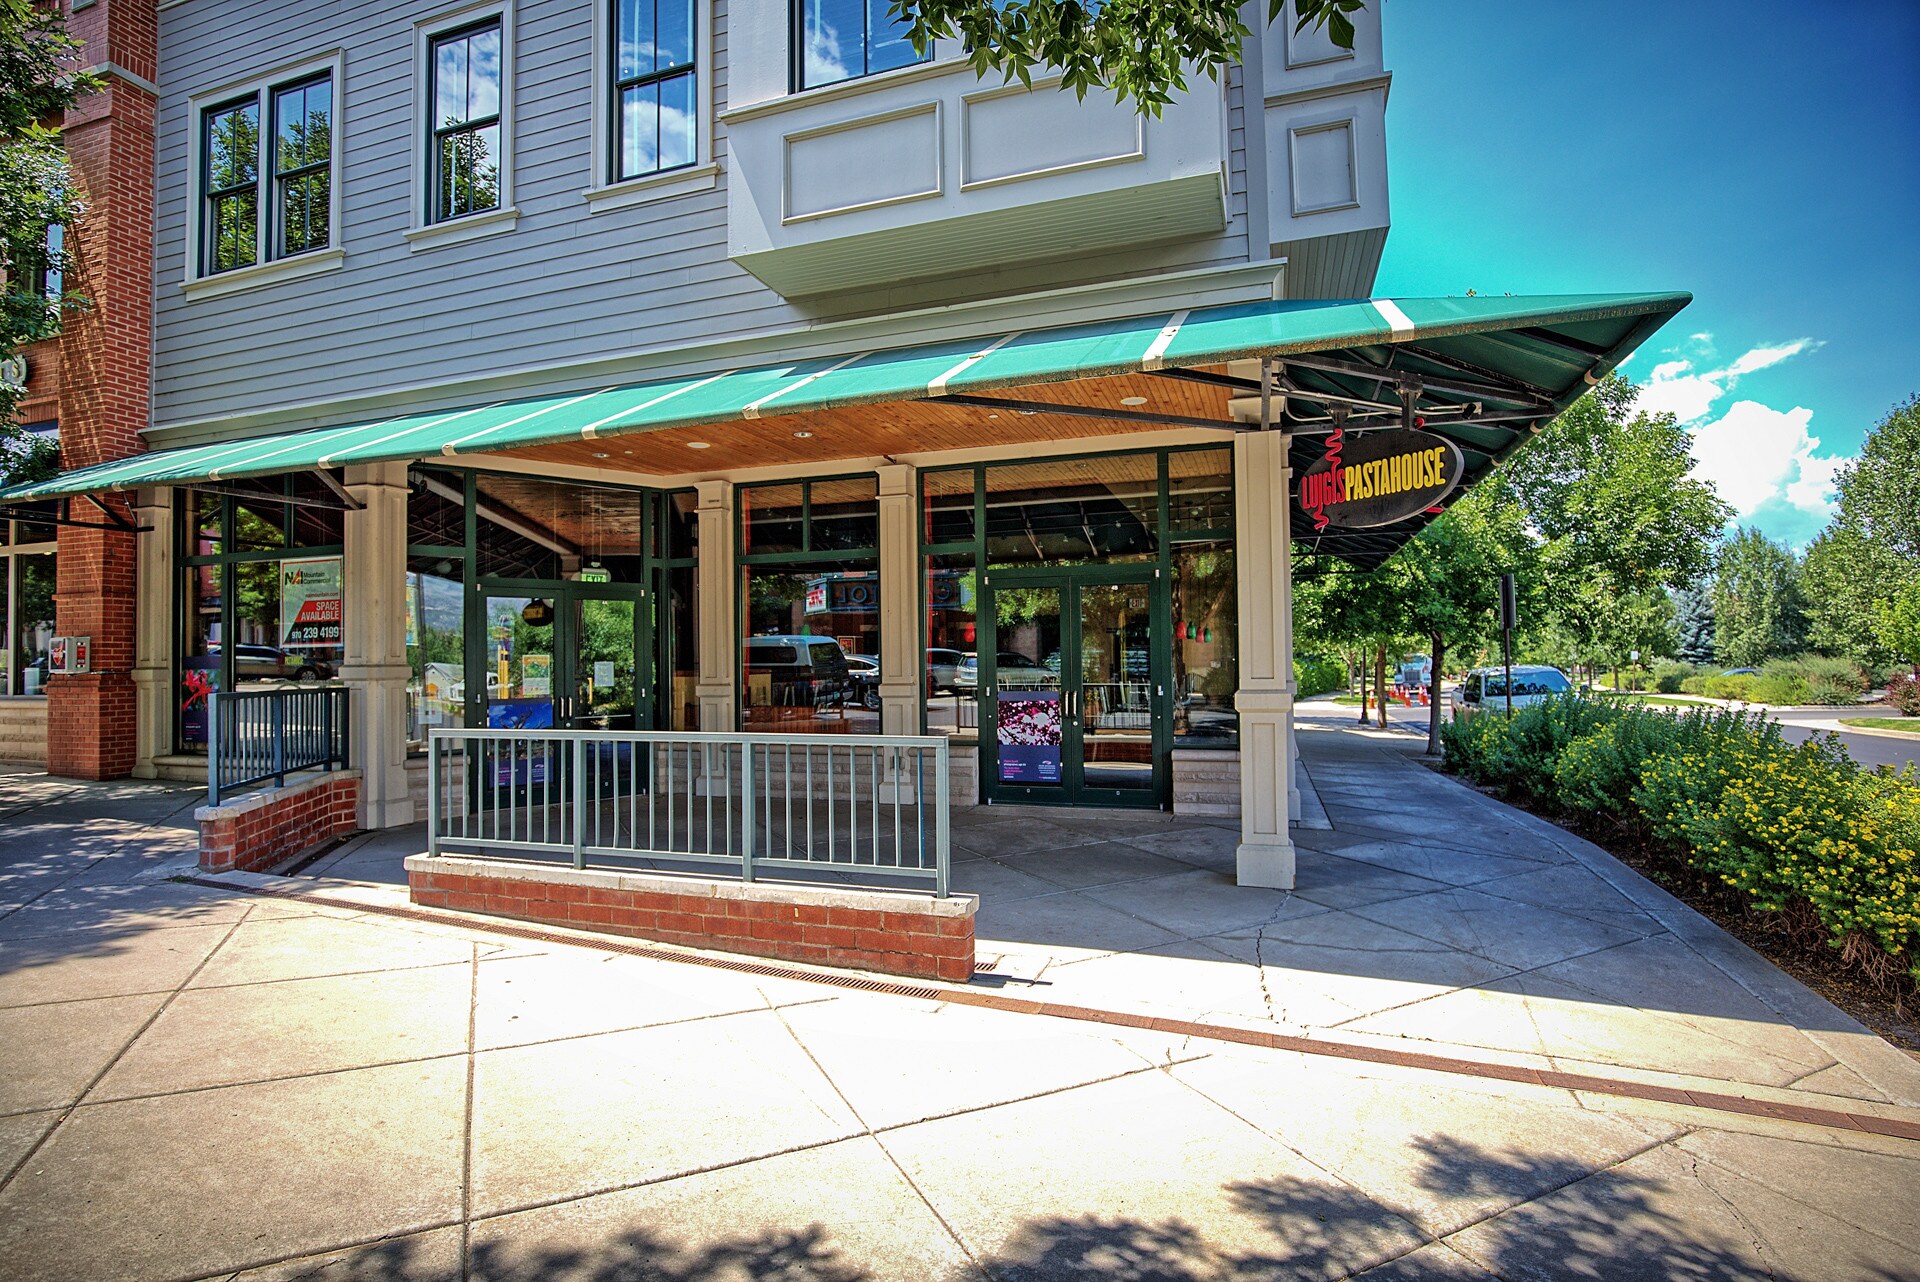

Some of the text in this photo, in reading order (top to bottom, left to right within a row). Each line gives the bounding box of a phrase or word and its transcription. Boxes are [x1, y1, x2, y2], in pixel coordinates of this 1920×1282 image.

[285, 568, 303, 585] NAI
[316, 601, 339, 611] SPACE
[301, 611, 339, 620] AVAILABLE
[291, 627, 339, 639] 970 239 4199
